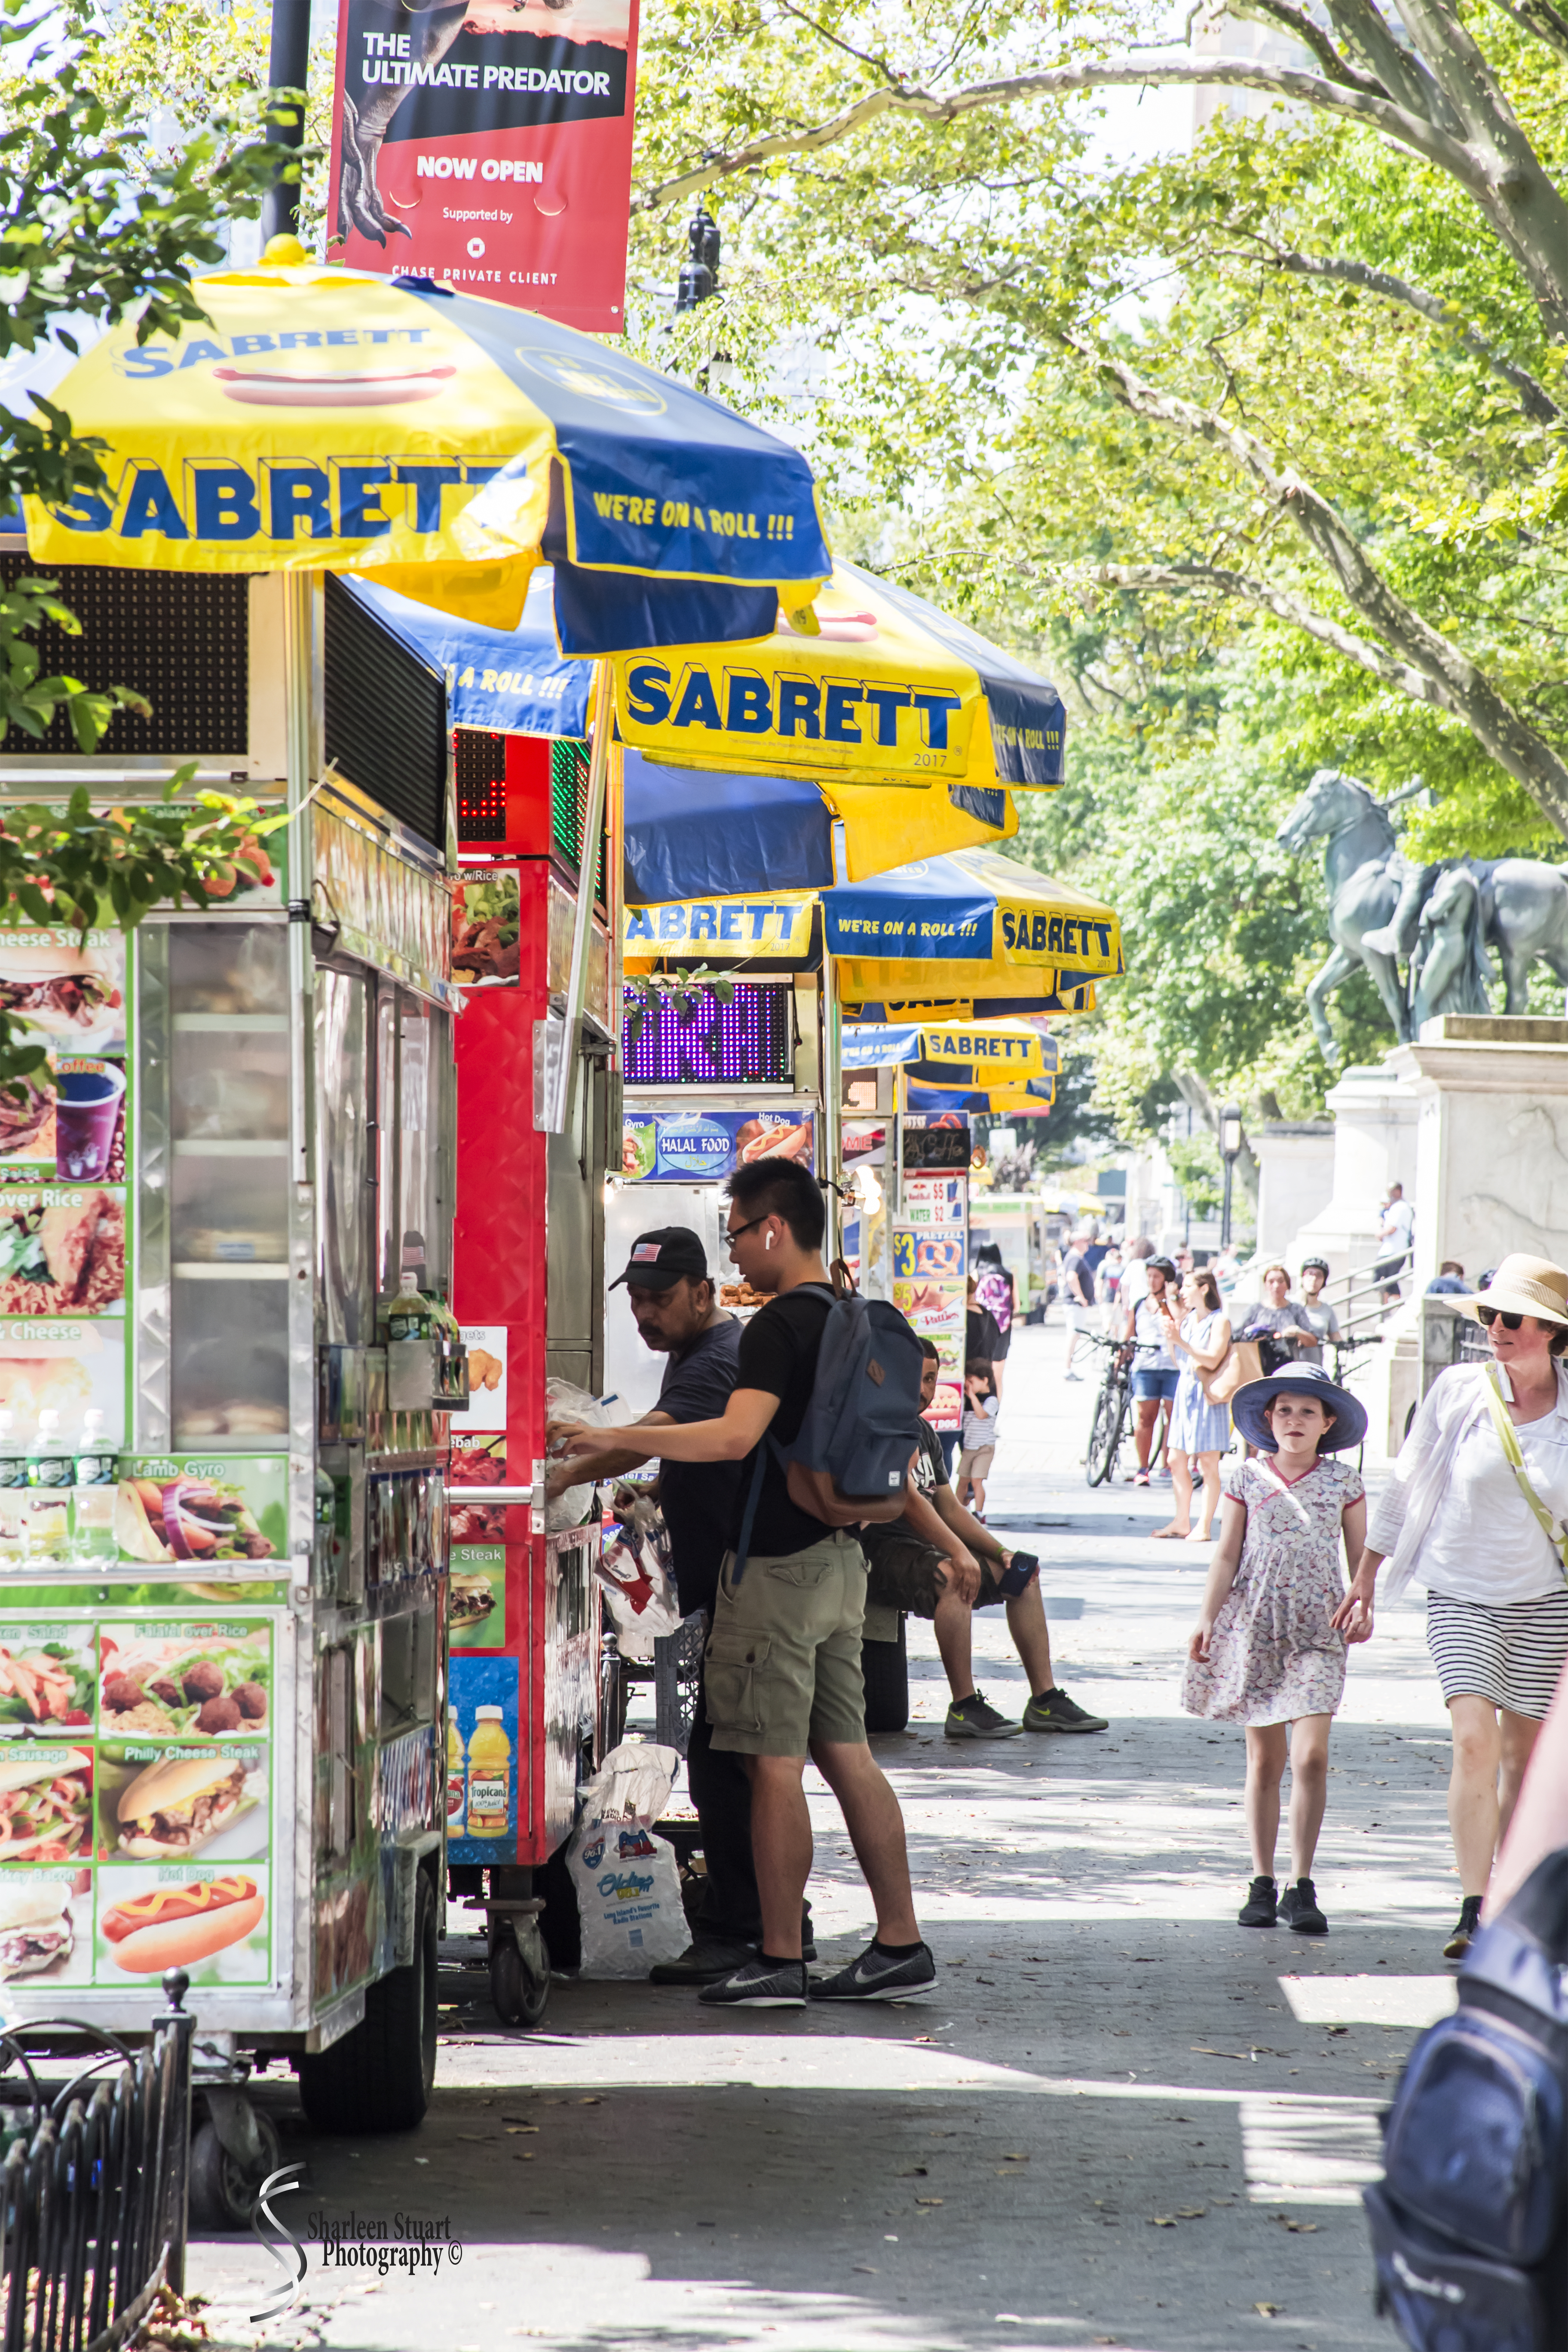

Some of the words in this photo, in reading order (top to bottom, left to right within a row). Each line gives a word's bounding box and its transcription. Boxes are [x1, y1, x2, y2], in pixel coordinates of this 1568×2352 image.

[362, 32, 410, 58] THE
[361, 59, 478, 89] ULTIMATE
[483, 65, 610, 96] PREDATOR
[417, 156, 477, 181] NOW
[481, 159, 543, 184] OPEN
[443, 207, 497, 222] Supported
[500, 210, 513, 224] by
[392, 265, 435, 280] CHASE
[443, 268, 502, 283] PRIVATE
[508, 271, 558, 285] CLIENT
[115, 328, 430, 379] SABRETT
[593, 492, 656, 525] WE'RE
[661, 500, 690, 528] ON
[694, 507, 706, 532] A
[707, 509, 761, 539] ROLL
[767, 515, 794, 541] !!!
[457, 666, 475, 688] A
[480, 669, 534, 696] ROLL
[538, 676, 571, 700] !!!
[625, 656, 962, 750] SABRETT
[1046, 731, 1059, 750] !!!
[913, 753, 947, 768] 2017
[464, 870, 498, 882] w/Rice
[625, 900, 803, 940] ABRETT
[838, 919, 879, 934] WE'RE
[883, 922, 904, 935] ON
[907, 923, 916, 936] A
[921, 922, 956, 937] ROLL
[960, 923, 978, 937] !!!
[0, 933, 51, 947] eese
[1001, 908, 1112, 957] SABRETT
[770, 943, 790, 952] 2017
[1096, 959, 1110, 968] 2017
[929, 1035, 1031, 1057] SABRETT
[625, 1118, 644, 1129] Gyro
[759, 1112, 773, 1122] Hot
[774, 1115, 790, 1127] Dog
[662, 1138, 697, 1152] HALAL
[701, 1138, 730, 1152] FOOD
[0, 1167, 40, 1178] Salad
[42, 1188, 83, 1208] Rice
[933, 1183, 943, 1200] $5
[909, 1209, 931, 1222] WATER
[934, 1206, 943, 1222] $2
[894, 1233, 916, 1277] $3
[916, 1231, 964, 1240] PRETZEL
[894, 1283, 912, 1311] $5
[11, 1322, 82, 1340] Cheese
[459, 1329, 485, 1342] gets
[937, 1419, 958, 1429] DOG
[450, 1436, 481, 1448] bab
[132, 1461, 178, 1478] Lamb
[184, 1461, 225, 1479] Gyro
[461, 1549, 502, 1561] Steak
[28, 1625, 67, 1639] Salad
[135, 1625, 181, 1638] Falafel
[184, 1626, 214, 1638] over
[218, 1624, 248, 1637] Rice
[8, 1748, 67, 1764] Sausage
[124, 1746, 162, 1762] Philly
[165, 1746, 216, 1761] Cheese
[220, 1744, 260, 1759] Steak
[471, 1785, 507, 1799] Tropicana
[33, 1868, 76, 1882] Bacon
[158, 1868, 184, 1882] Hot
[187, 1868, 215, 1883] Dog
